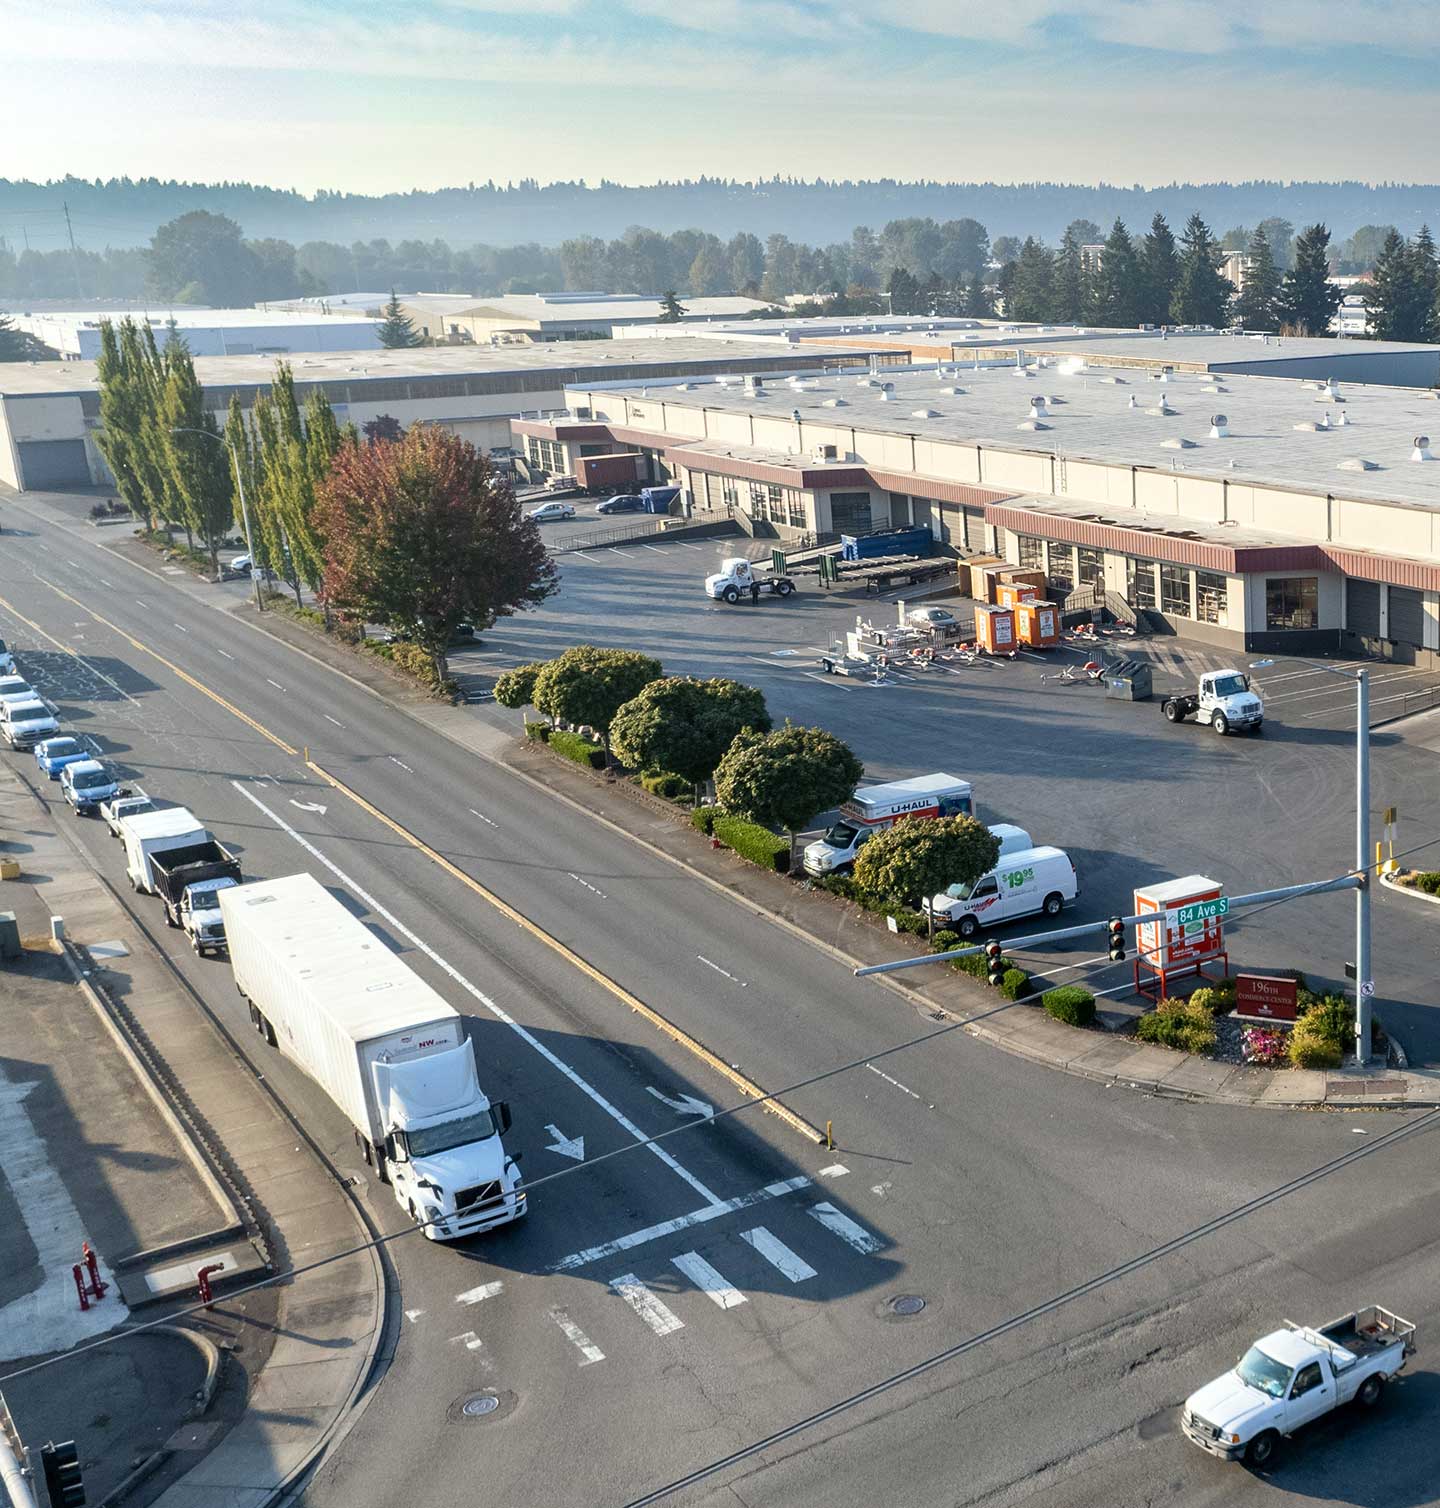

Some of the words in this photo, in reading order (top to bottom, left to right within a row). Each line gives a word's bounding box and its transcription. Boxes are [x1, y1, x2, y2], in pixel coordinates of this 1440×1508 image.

[891, 799, 932, 813] U-HAUL
[1180, 908, 1193, 922] 84
[1197, 904, 1216, 917] Ave
[1220, 900, 1226, 912] S
